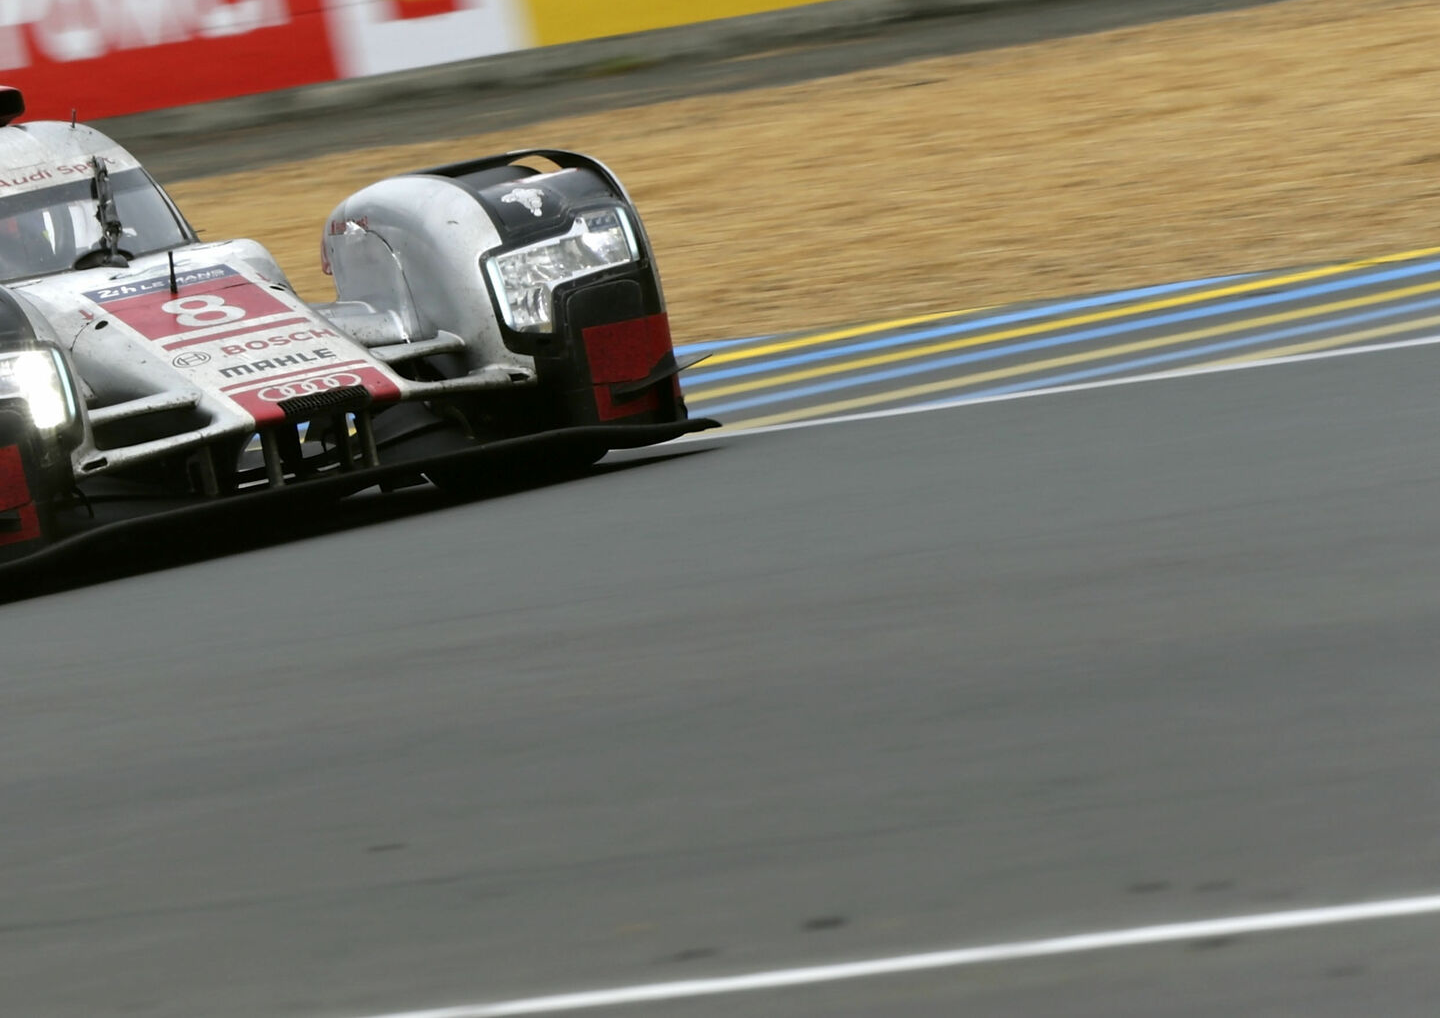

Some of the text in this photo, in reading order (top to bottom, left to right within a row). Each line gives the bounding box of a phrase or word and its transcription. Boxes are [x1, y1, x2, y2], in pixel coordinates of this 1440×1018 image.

[140, 280, 164, 290] LE
[161, 294, 247, 327] 8
[220, 328, 339, 357] BOSCH
[219, 347, 336, 378] MAHLE
